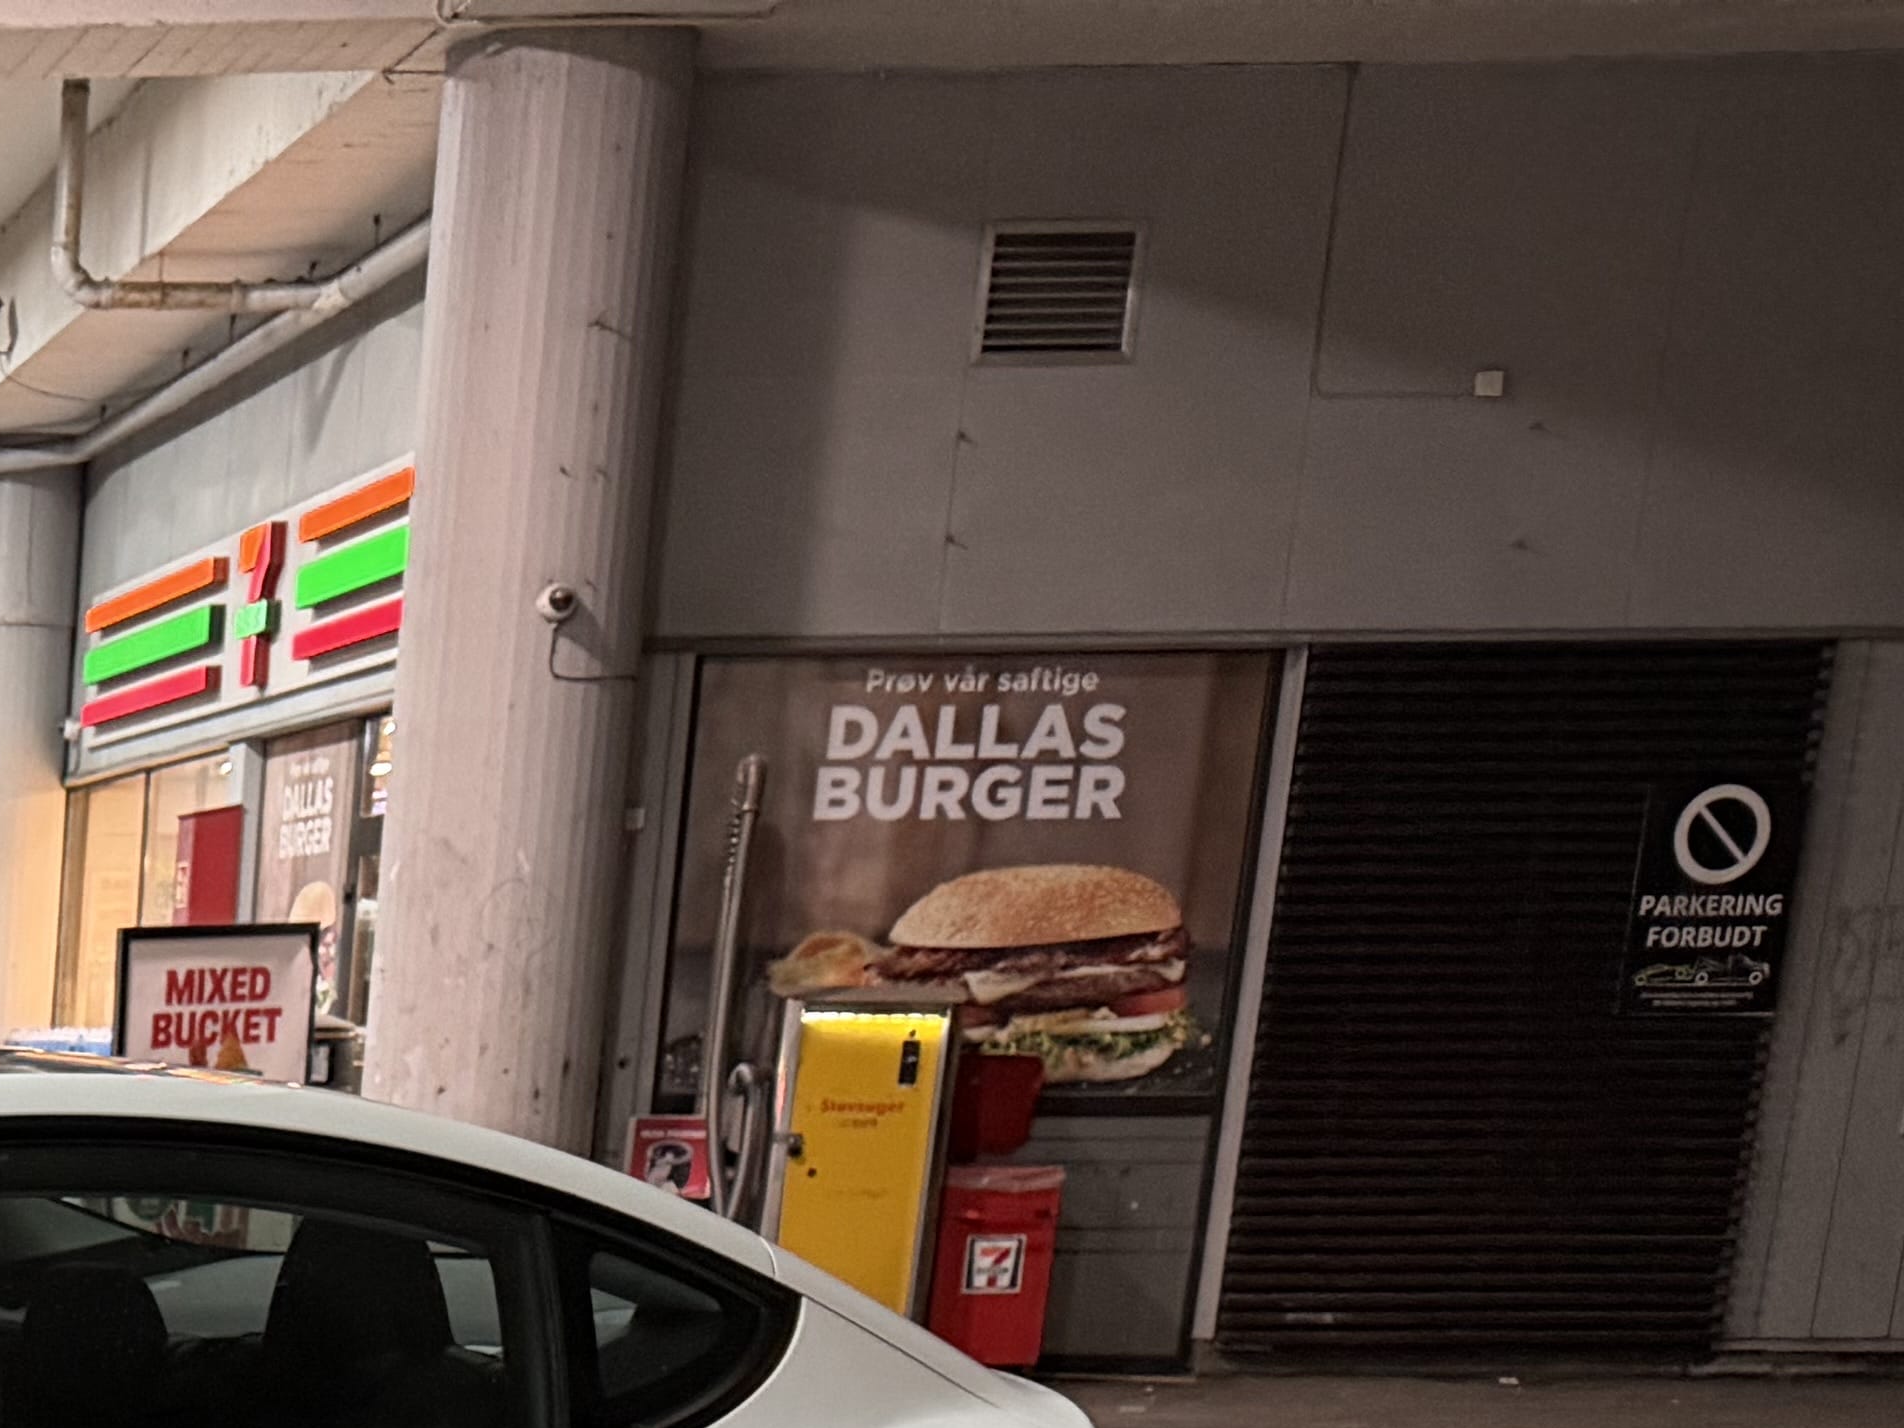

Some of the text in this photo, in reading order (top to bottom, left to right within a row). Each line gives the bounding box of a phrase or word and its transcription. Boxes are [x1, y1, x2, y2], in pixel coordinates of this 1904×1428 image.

[866, 664, 1100, 697] Prøv vår saftige
[826, 703, 1127, 761] DALLAS
[282, 776, 334, 822] DALLAS
[812, 764, 1126, 821] BURGER
[279, 816, 333, 859] BURGER
[1637, 893, 1785, 917] PARKERING
[1645, 925, 1769, 949] FORBUDT
[165, 966, 271, 1006] MIXED
[150, 1007, 283, 1050] BUCKET
